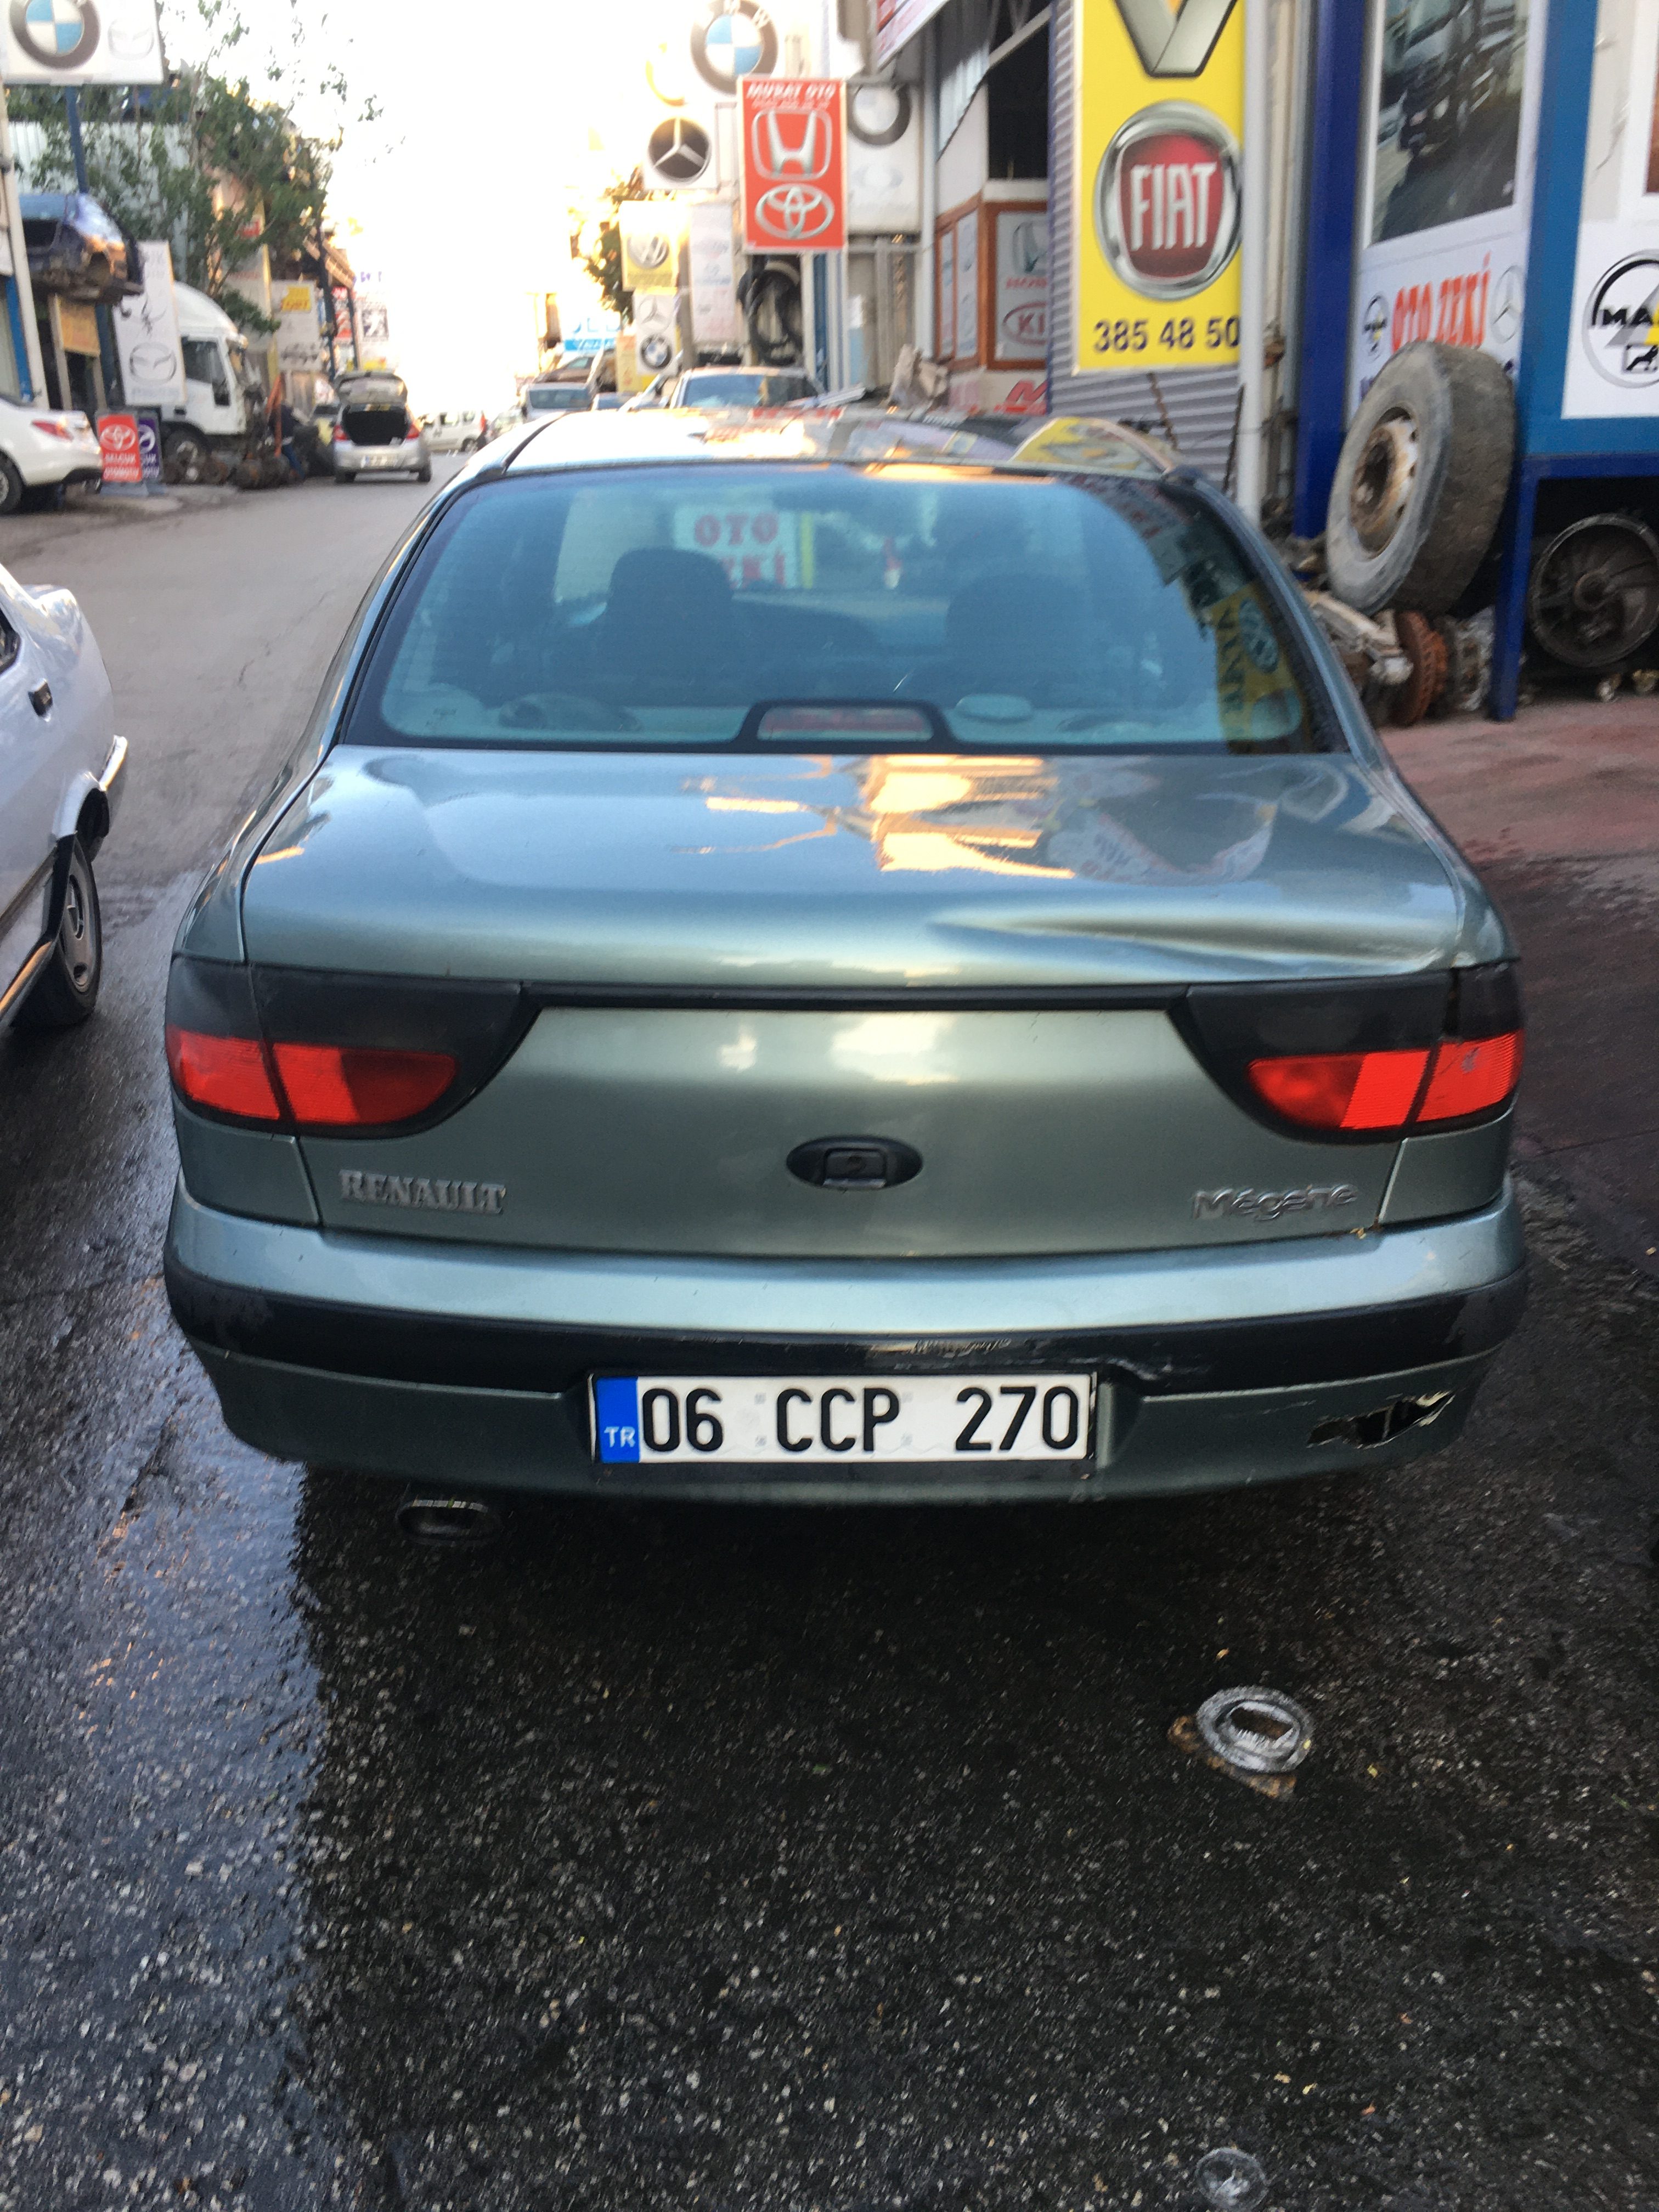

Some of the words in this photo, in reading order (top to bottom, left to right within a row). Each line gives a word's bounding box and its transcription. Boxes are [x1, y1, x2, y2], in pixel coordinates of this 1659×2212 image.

[804, 82, 837, 100] OTO
[1130, 162, 1217, 252] FIAT
[1018, 312, 1046, 334] KI
[1094, 318, 1148, 353] 385
[1159, 317, 1195, 351] 48
[1206, 315, 1240, 349] 50
[1599, 307, 1659, 327] MA
[695, 511, 779, 547] OTO
[338, 1169, 506, 1215] RENAULT
[641, 1387, 724, 1453] 06
[776, 1387, 901, 1453] CCP
[955, 1385, 1080, 1452] 270
[603, 1426, 636, 1449] TR
